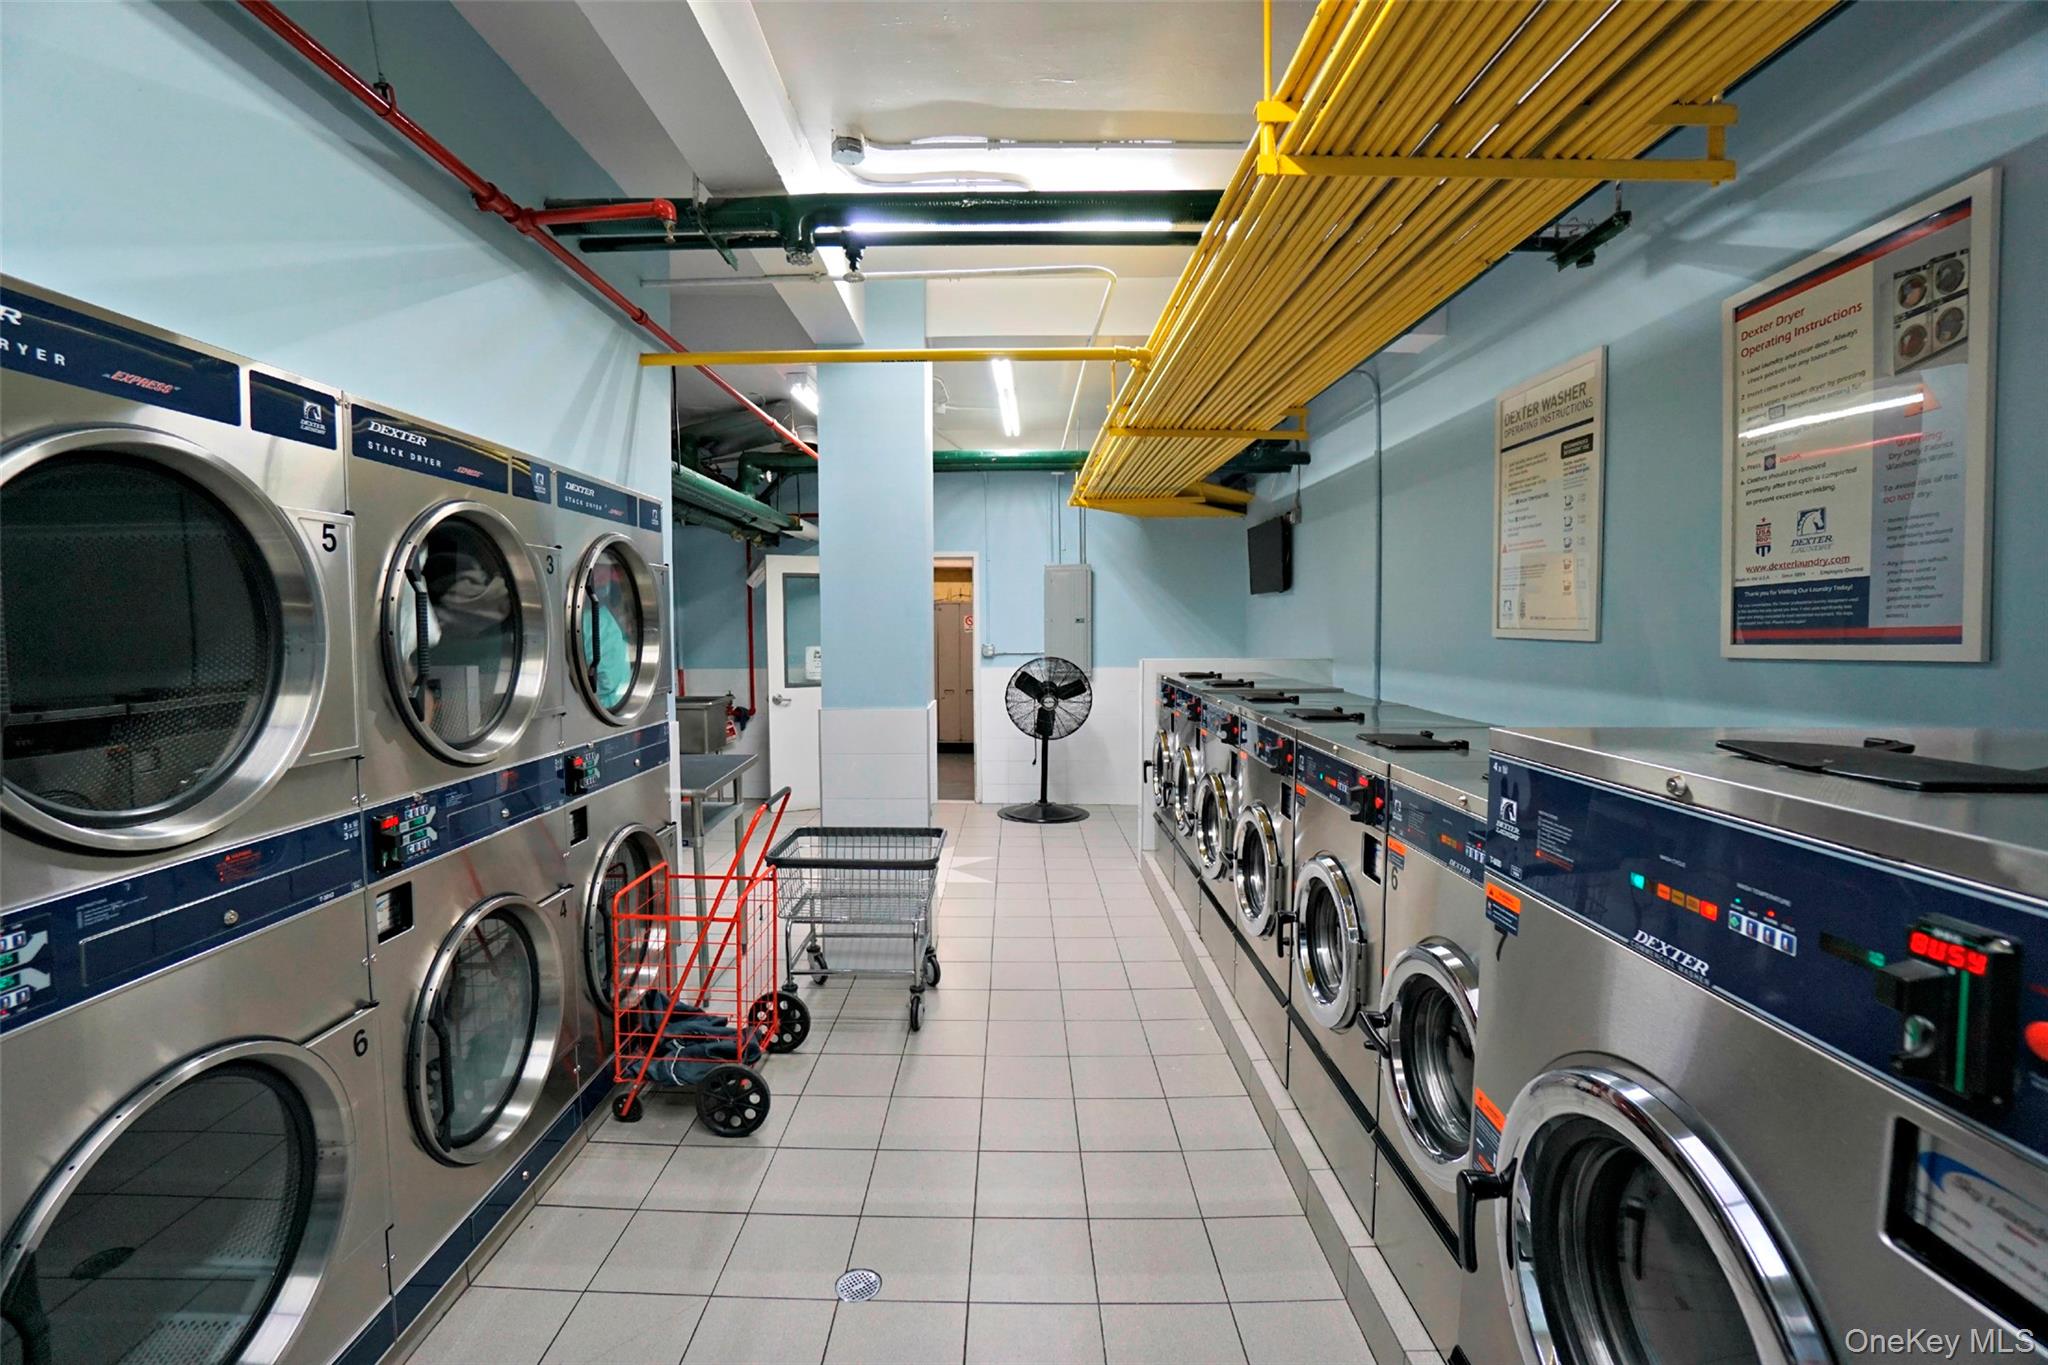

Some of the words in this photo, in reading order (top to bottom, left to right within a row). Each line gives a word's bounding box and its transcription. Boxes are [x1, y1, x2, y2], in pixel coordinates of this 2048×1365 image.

[1740, 322, 1773, 341] Dexter
[1775, 308, 1805, 327] Dryer
[1740, 332, 1792, 358] Operating
[1794, 303, 1862, 336] Instructions
[1784, 351, 1796, 360] and
[1832, 329, 1857, 342] Always
[111, 370, 174, 394] EXPRESS
[1504, 401, 1539, 427] DEXTER
[1541, 382, 1587, 412] WASHER
[1504, 418, 1538, 439] OPERATING
[1540, 396, 1593, 424] INSTRUCTIONS
[368, 421, 427, 447] DEXTER
[368, 441, 404, 457] STACK
[410, 453, 442, 467] DRYER
[1888, 450, 1901, 462] Dry
[1768, 470, 1788, 480] should
[1798, 462, 1826, 473] removed
[565, 481, 595, 497] DEXTER
[1883, 484, 1892, 492] To
[1896, 491, 1914, 502] NOT
[322, 524, 337, 552] 5
[1791, 535, 1833, 547] DEXTER
[546, 555, 554, 575] 3
[1746, 555, 1850, 573] www.dexterlaundry.com
[1809, 585, 1832, 593] Laundry
[1833, 583, 1853, 592] Today!
[1493, 762, 1498, 771] 4
[1391, 866, 1398, 890] 6
[560, 899, 567, 918] 4
[1633, 930, 1709, 976] DEXTER
[353, 1029, 368, 1057] 6
